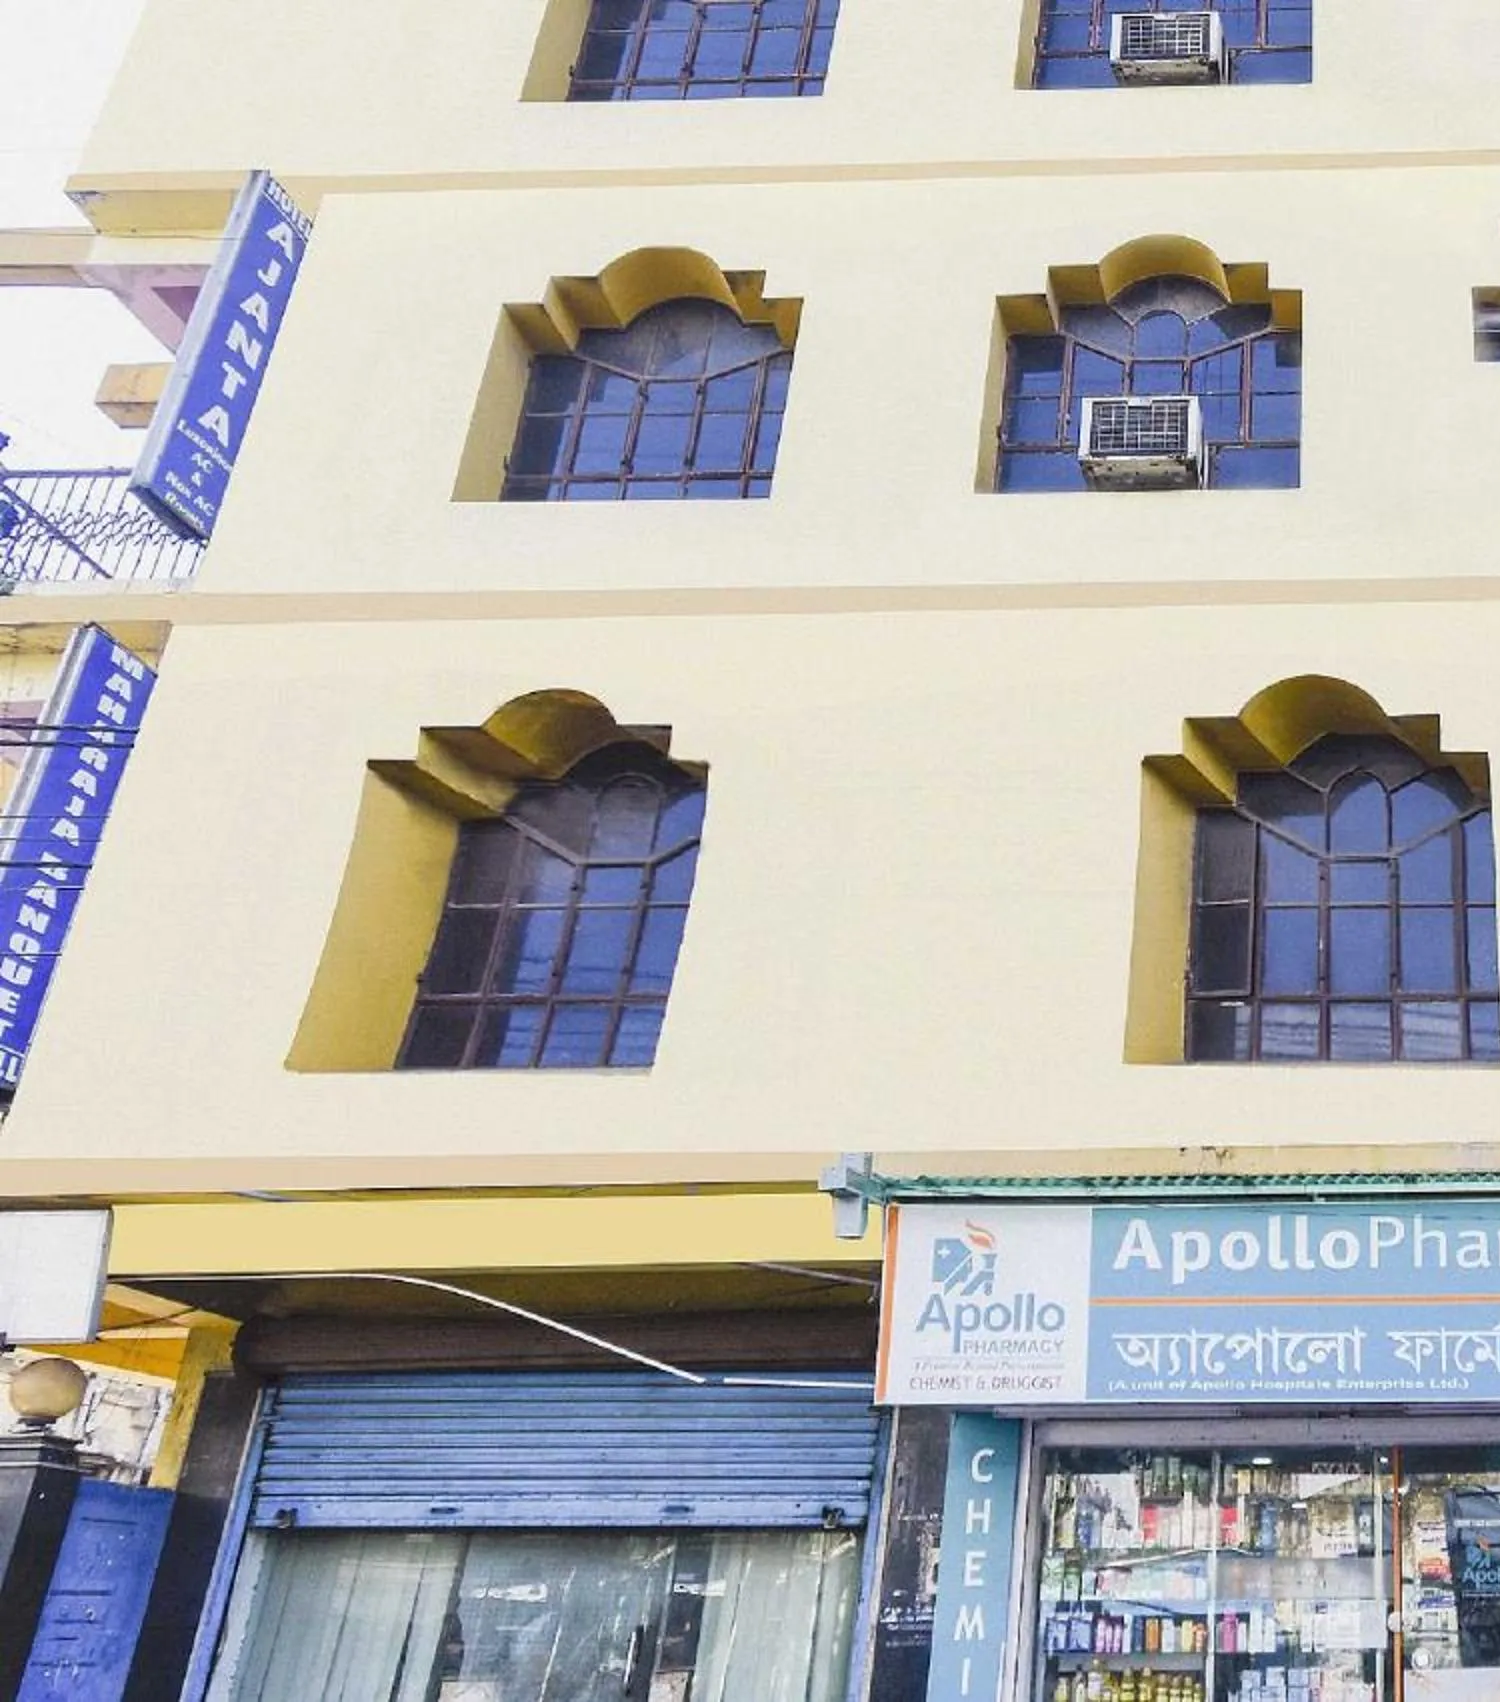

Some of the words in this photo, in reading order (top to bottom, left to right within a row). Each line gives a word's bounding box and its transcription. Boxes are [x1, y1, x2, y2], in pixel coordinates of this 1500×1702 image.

[197, 221, 294, 449] AJANTA
[50, 645, 144, 847] MAHARAJA
[916, 1293, 1065, 1353] Apollo
[962, 1339, 1065, 1355] PHARMACY
[909, 1375, 970, 1391] CHEMIST
[1190, 1379, 1246, 1392] Apollo
[953, 1447, 995, 1696] CHEMI
